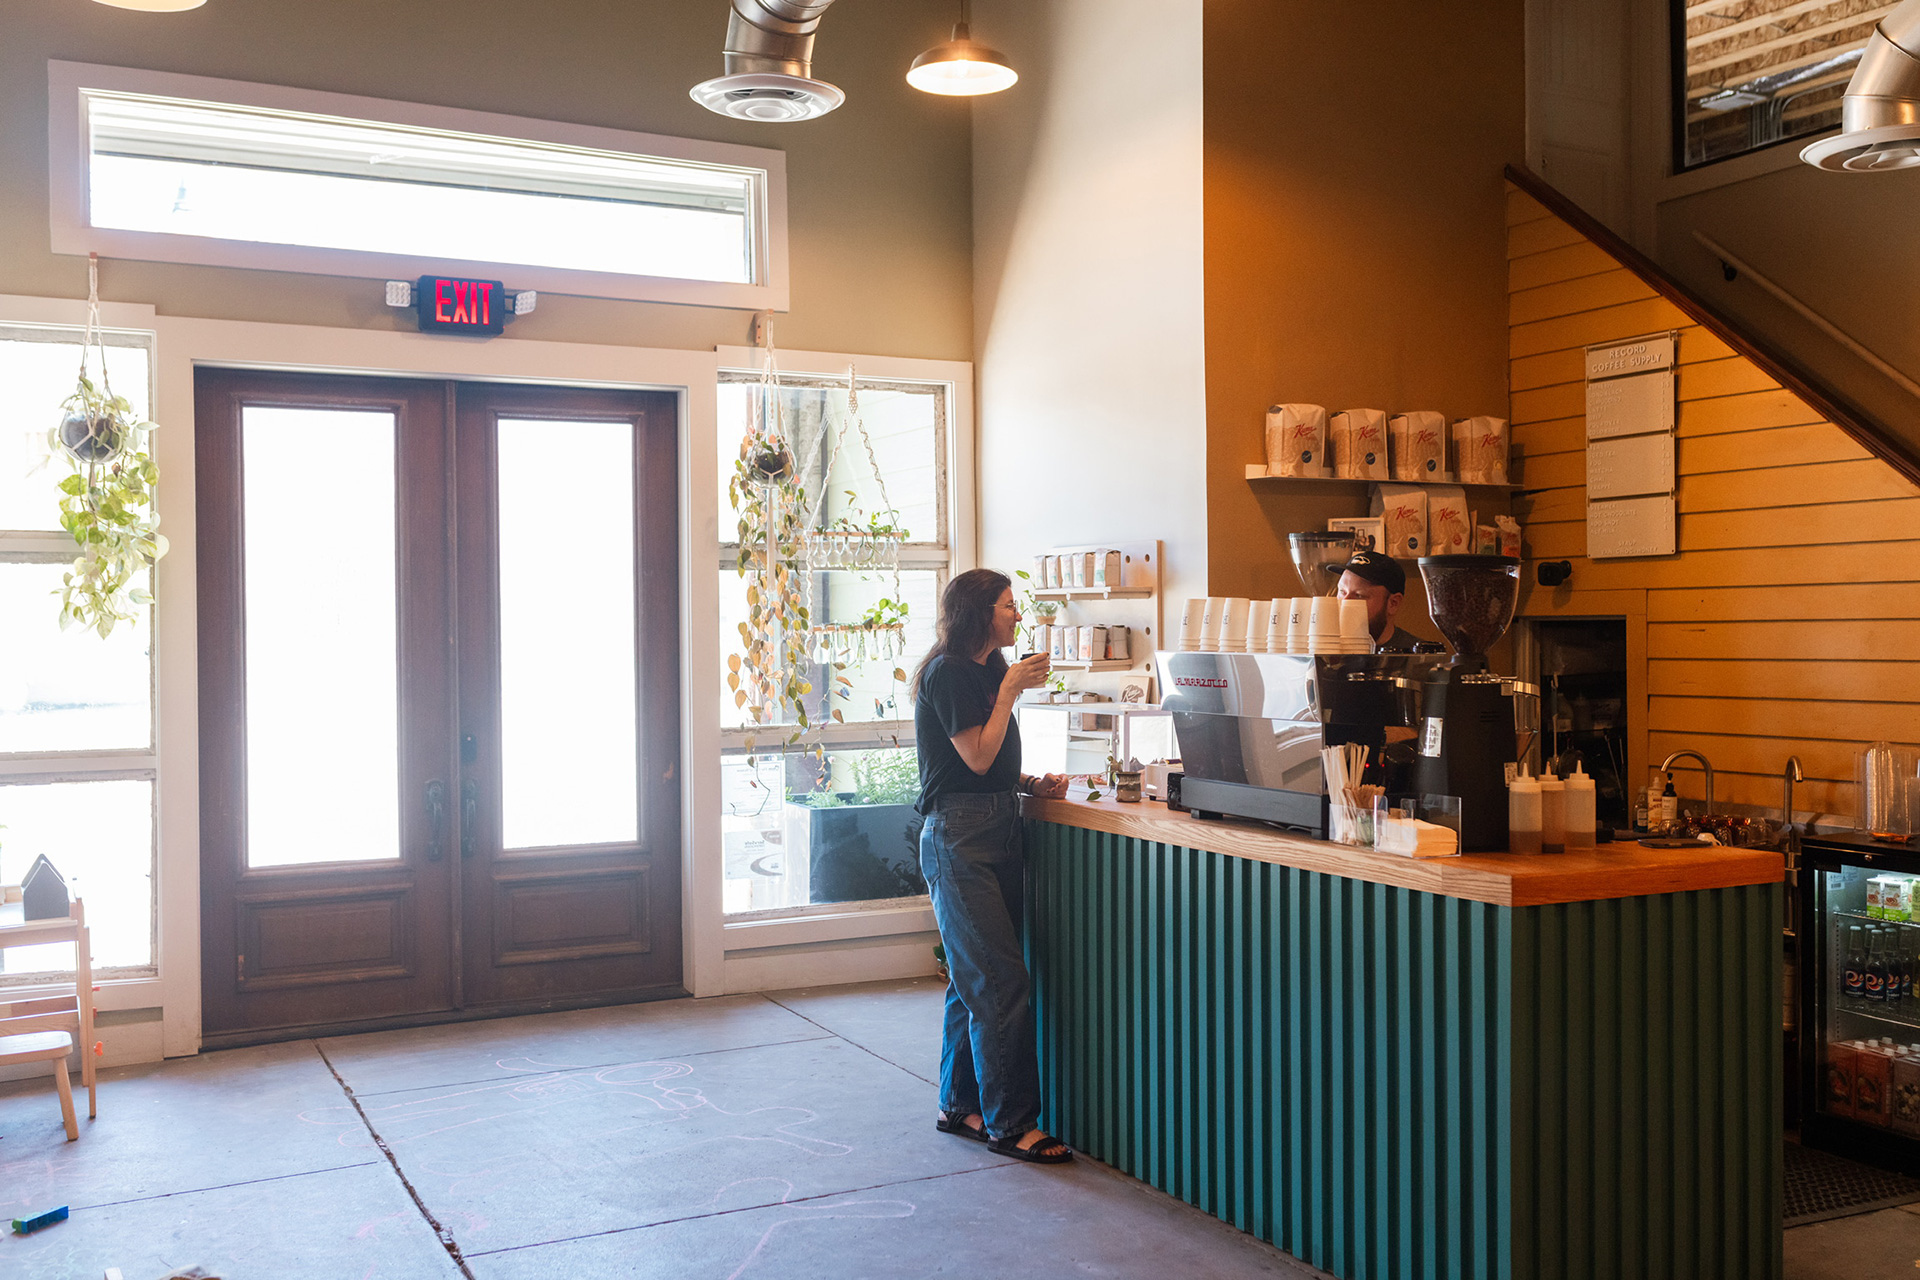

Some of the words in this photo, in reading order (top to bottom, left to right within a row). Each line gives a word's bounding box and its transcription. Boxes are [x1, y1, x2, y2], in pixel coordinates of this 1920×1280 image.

[436, 280, 493, 325] EXIT
[1609, 344, 1647, 359] RECORD
[1592, 360, 1626, 373] COFFEE
[1630, 353, 1662, 367] SUPPLY
